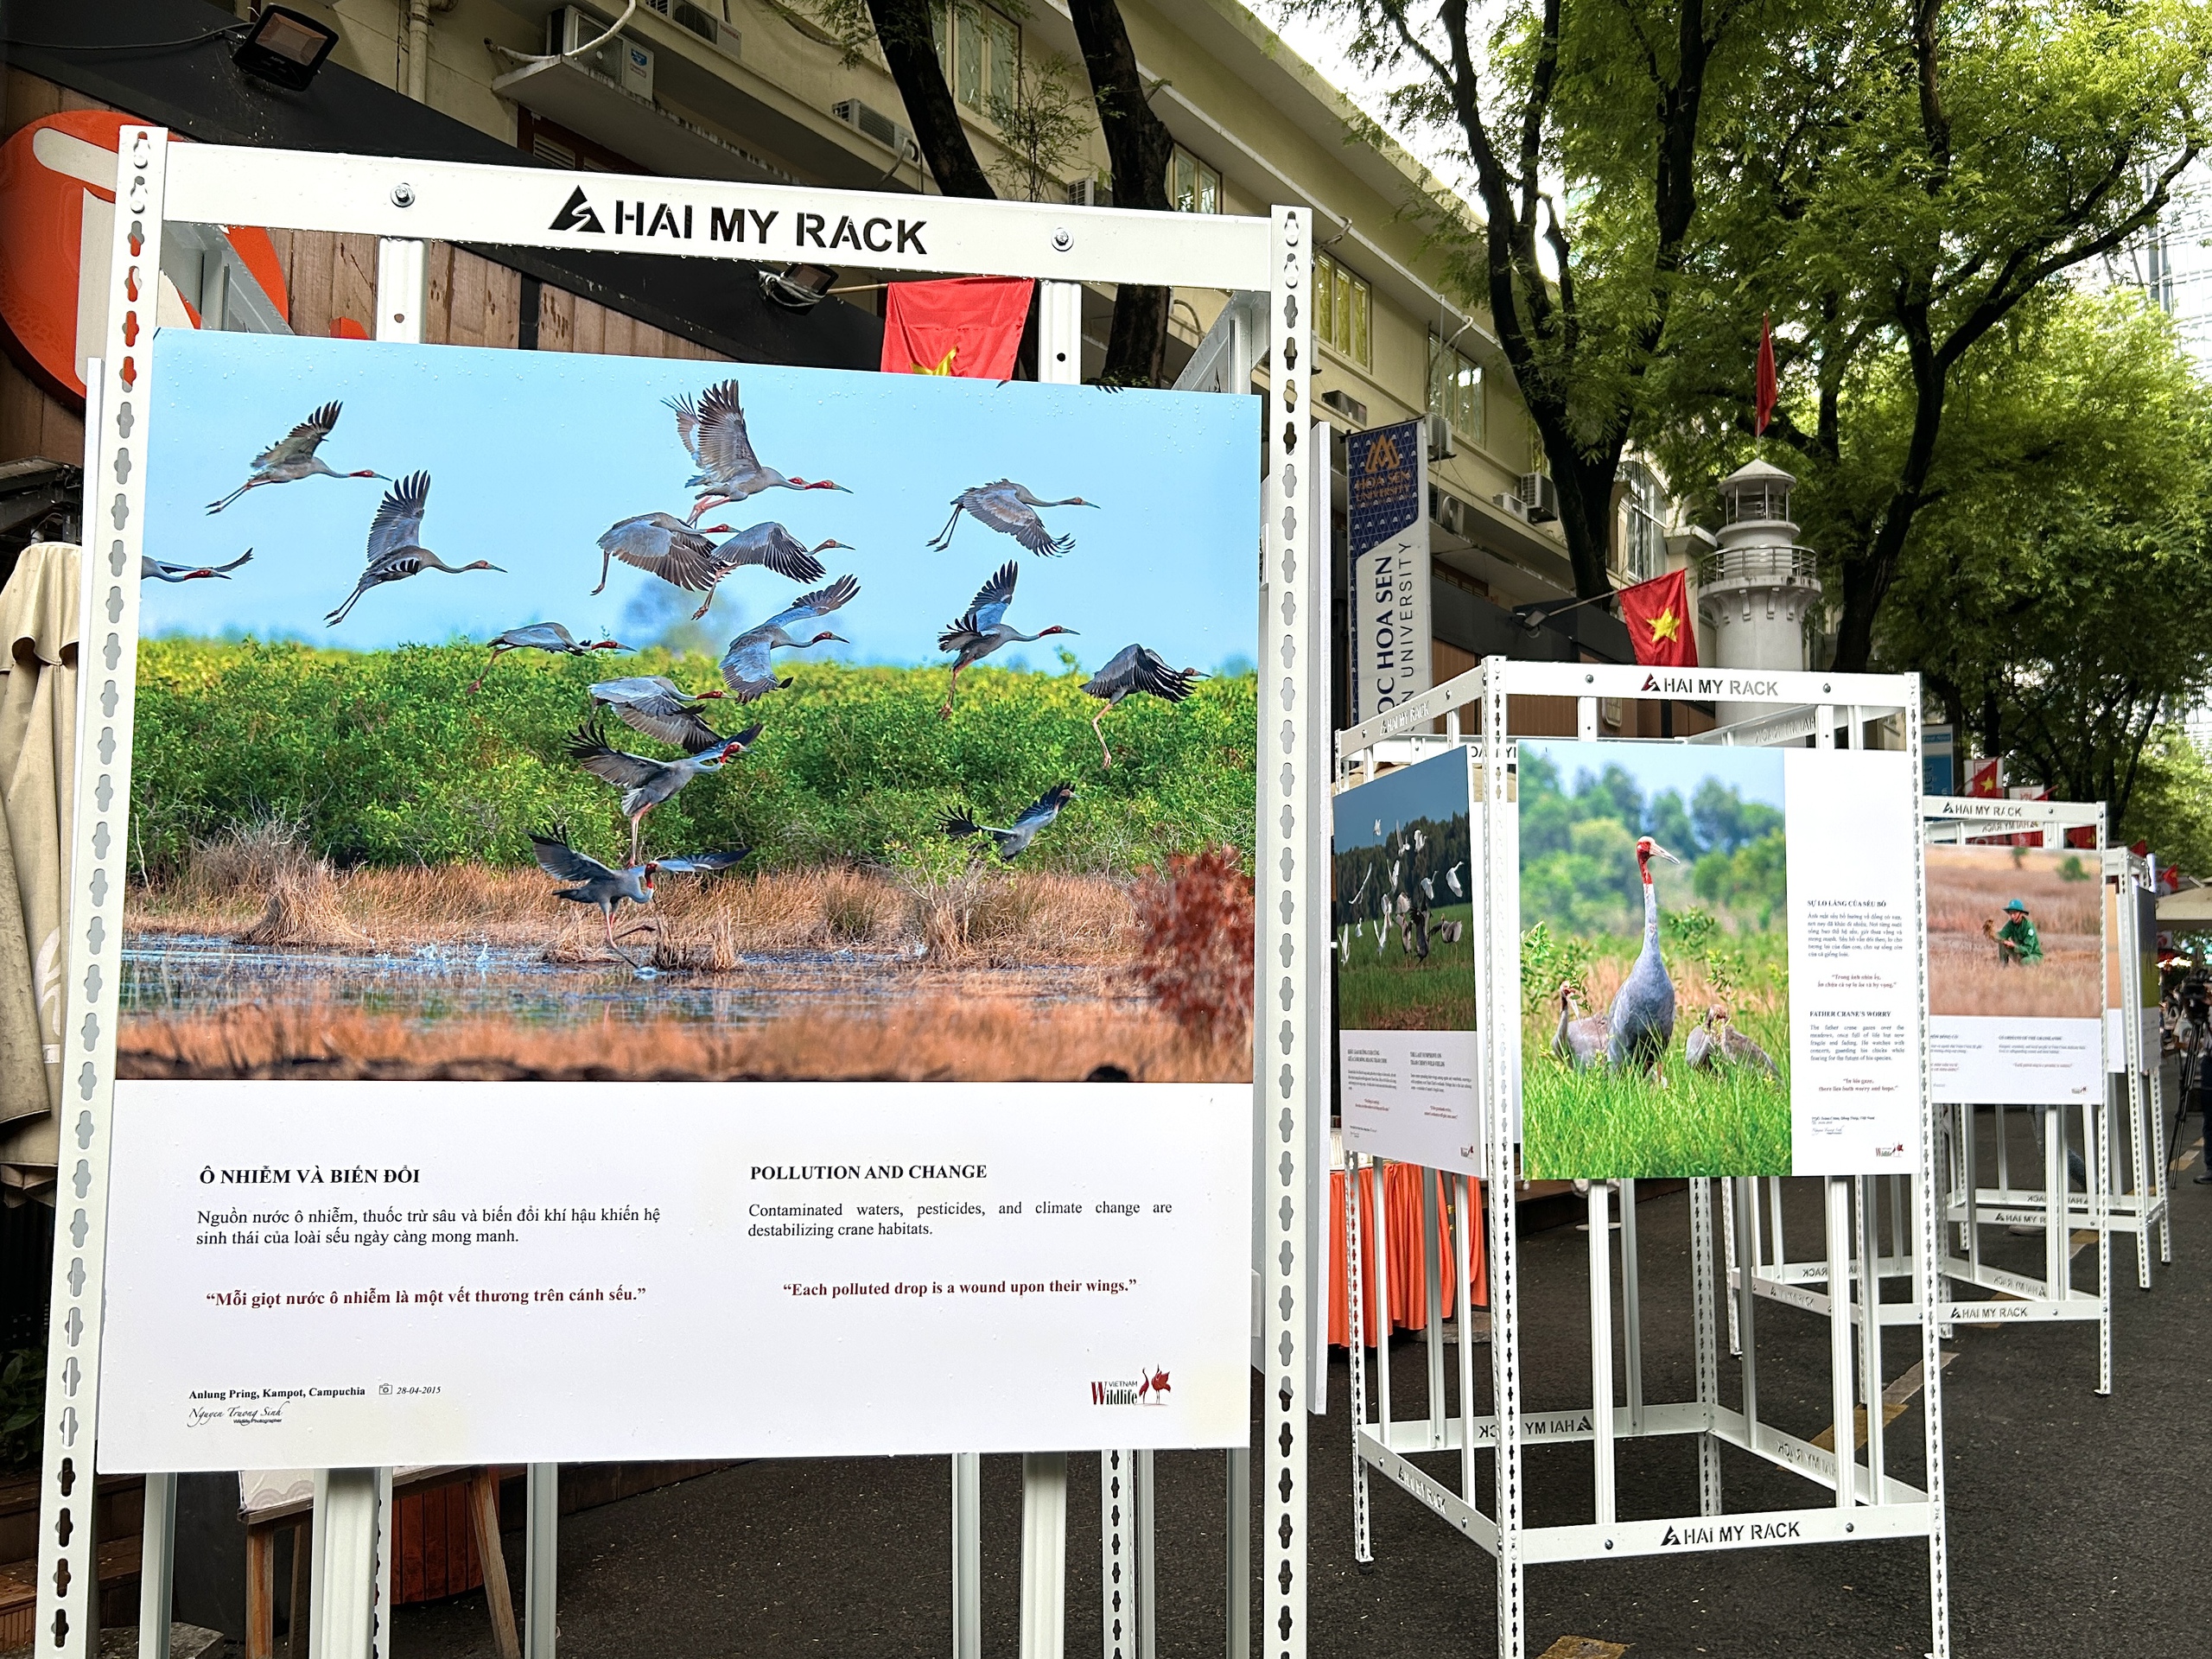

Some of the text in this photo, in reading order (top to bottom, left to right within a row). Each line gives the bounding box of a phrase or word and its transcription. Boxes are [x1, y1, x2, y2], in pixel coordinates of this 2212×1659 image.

[615, 200, 927, 254] HAI MY RACK
[1355, 470, 1410, 490] HOA SEN
[1357, 485, 1410, 501] UNIVERSITY
[1375, 556, 1393, 602] SEN
[1399, 542, 1414, 678] UNIVERSITY
[1376, 610, 1394, 669] HOA
[1664, 677, 1778, 696] HAI MY RACK
[1409, 701, 1429, 722] RACK
[1955, 804, 2022, 817] HAI MY RACK
[200, 1165, 420, 1184] Ô NHIỄM VÀ BIẾN ĐỔI
[751, 1165, 987, 1179] POLLUTION AND CHANGE
[197, 1205, 660, 1227] Nguồn nước ô nhiễm, thuốc trừ sâu và biến đổi khí hậu khiến hệ
[749, 1201, 1172, 1218] Contaminated waters, pesticides, and climate change are
[196, 1226, 518, 1246] sinh thái của loài sếu ngày càng mong manh.
[748, 1222, 932, 1239] destabilizing crane habitats.
[207, 1284, 645, 1309] “Mỗi giọt nước ô nhiễm là một vết thương trên cánh sếu.”
[784, 1279, 1136, 1299] “Each polluted drop is a wound upon their wings.”
[1962, 1306, 2028, 1319] HAI MY RACK
[189, 1386, 442, 1401] Anlung Pring, Kampot, Campuchia 28-04-2015
[1090, 1381, 1138, 1405] Wildlife
[187, 1407, 225, 1427] Nguyen
[260, 1401, 290, 1416] Sinh
[1684, 1521, 1801, 1545] HAI MY RACK
